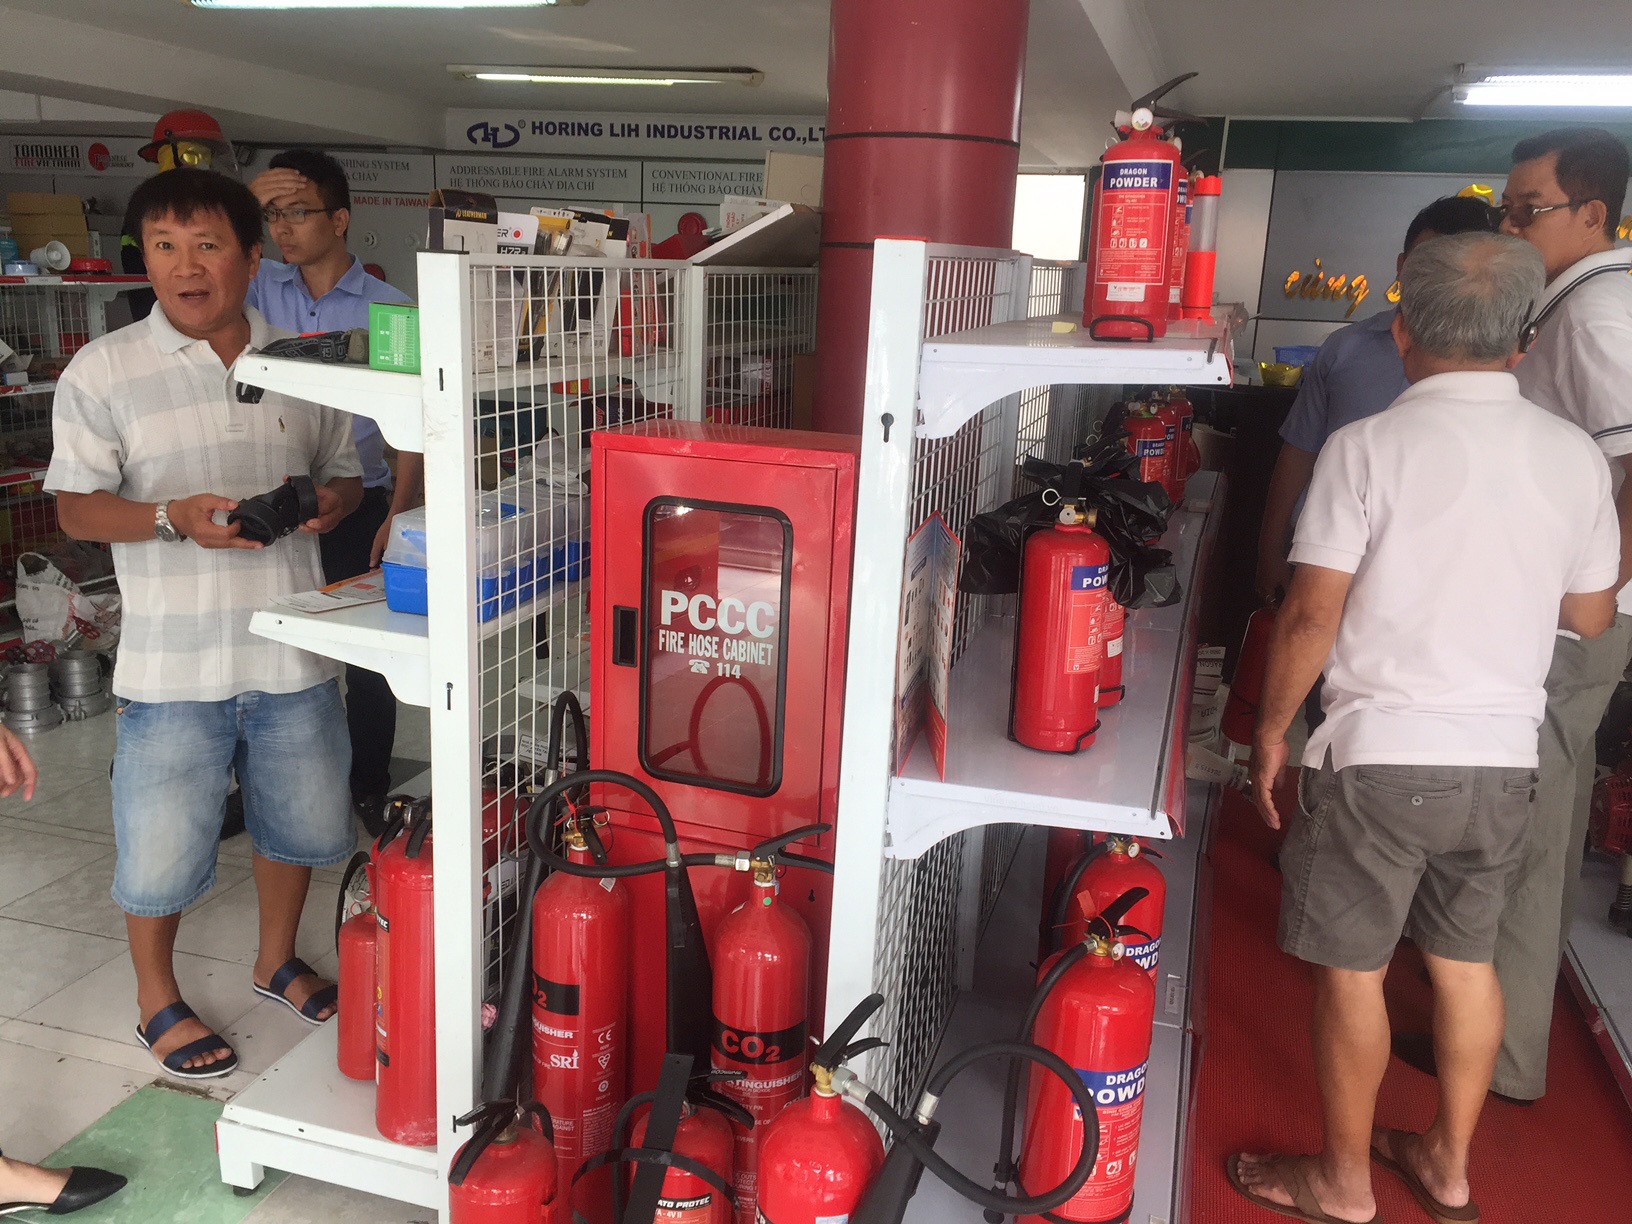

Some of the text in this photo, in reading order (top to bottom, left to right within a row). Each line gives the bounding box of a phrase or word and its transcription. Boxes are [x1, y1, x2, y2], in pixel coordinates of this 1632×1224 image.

[531, 121, 826, 144] HORING LIH INDUSTRIAL CO.,LT
[372, 160, 410, 171] SYSTEM
[450, 165, 628, 179] ADDRESSABLE FIRE ALARM SYSTEM
[1119, 168, 1147, 176] DRAGON
[651, 169, 763, 182] CONVENTIONAL FIRE
[1109, 177, 1158, 188] POWDER
[708, 182, 732, 195] BÁO
[733, 183, 764, 196] CHÁY
[353, 196, 430, 208] MADE IN TAIWAN
[1082, 574, 1109, 588] POW
[661, 589, 775, 639] PCCC
[659, 629, 773, 666] FIRE HOSE CABINET
[716, 662, 741, 679] 114
[1125, 939, 1161, 957] DRAGO
[721, 1030, 781, 1062] CO2
[1106, 1063, 1149, 1085] DRAGO
[657, 1196, 711, 1208] ATO PROTEC
